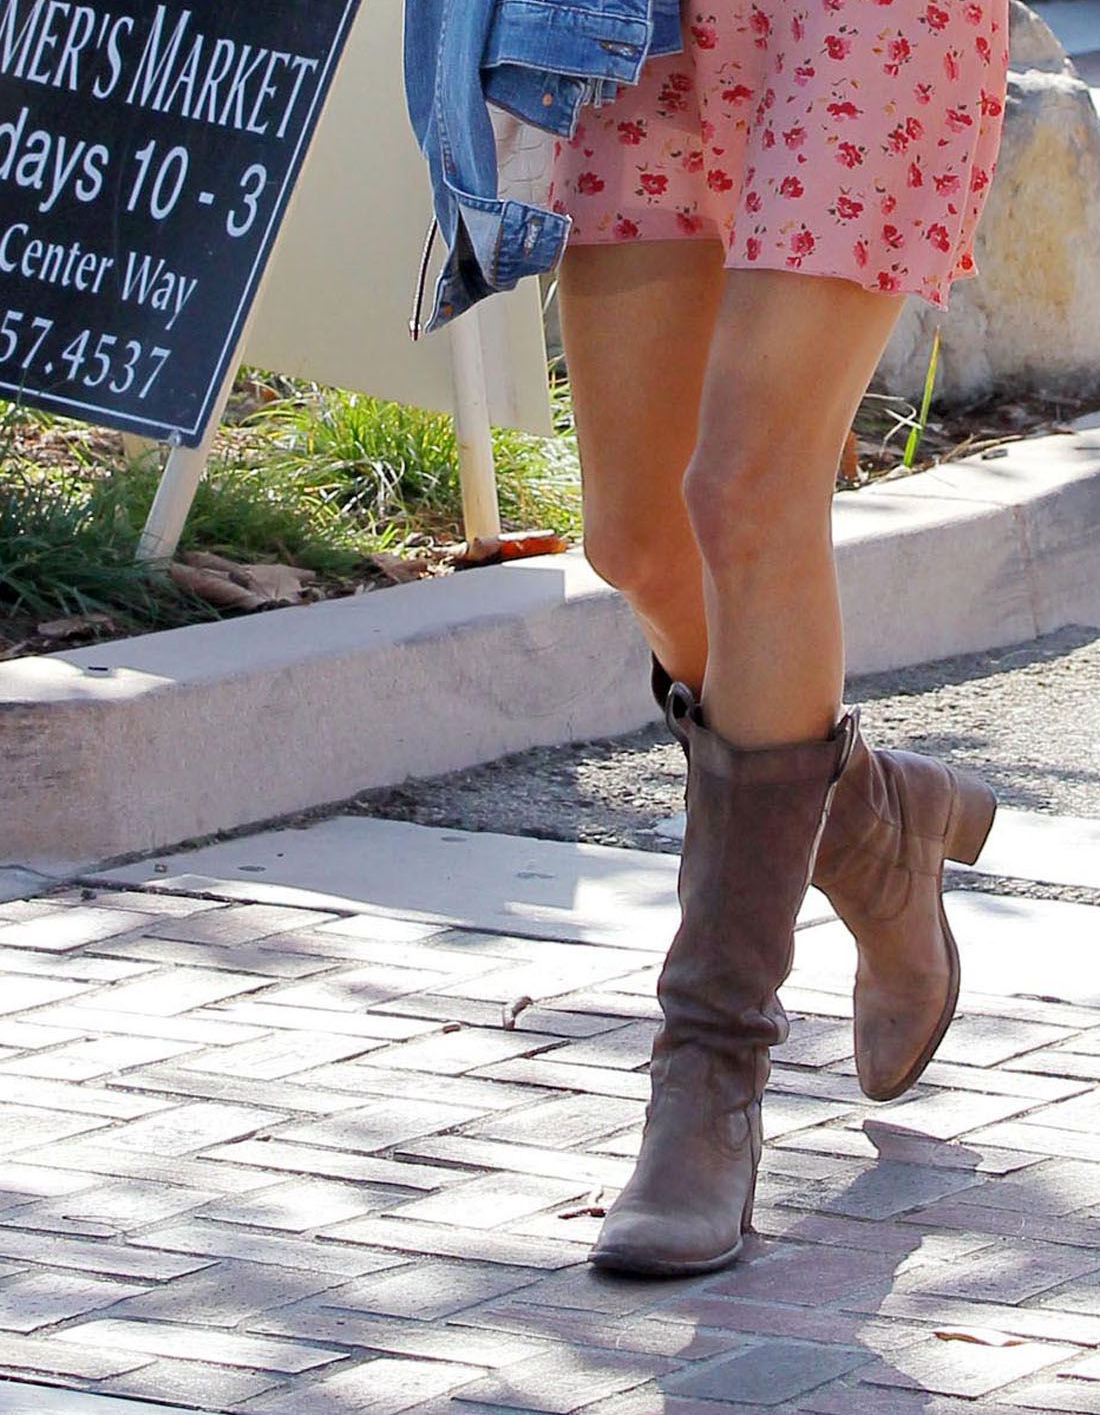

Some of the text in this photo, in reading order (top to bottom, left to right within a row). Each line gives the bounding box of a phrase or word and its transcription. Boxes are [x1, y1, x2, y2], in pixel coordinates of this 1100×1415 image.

[125, 4, 319, 138] MARKET
[127, 140, 189, 220] 10
[226, 163, 267, 237] 3
[0, 223, 198, 330] Center Way
[0, 310, 171, 398] 57.4537
